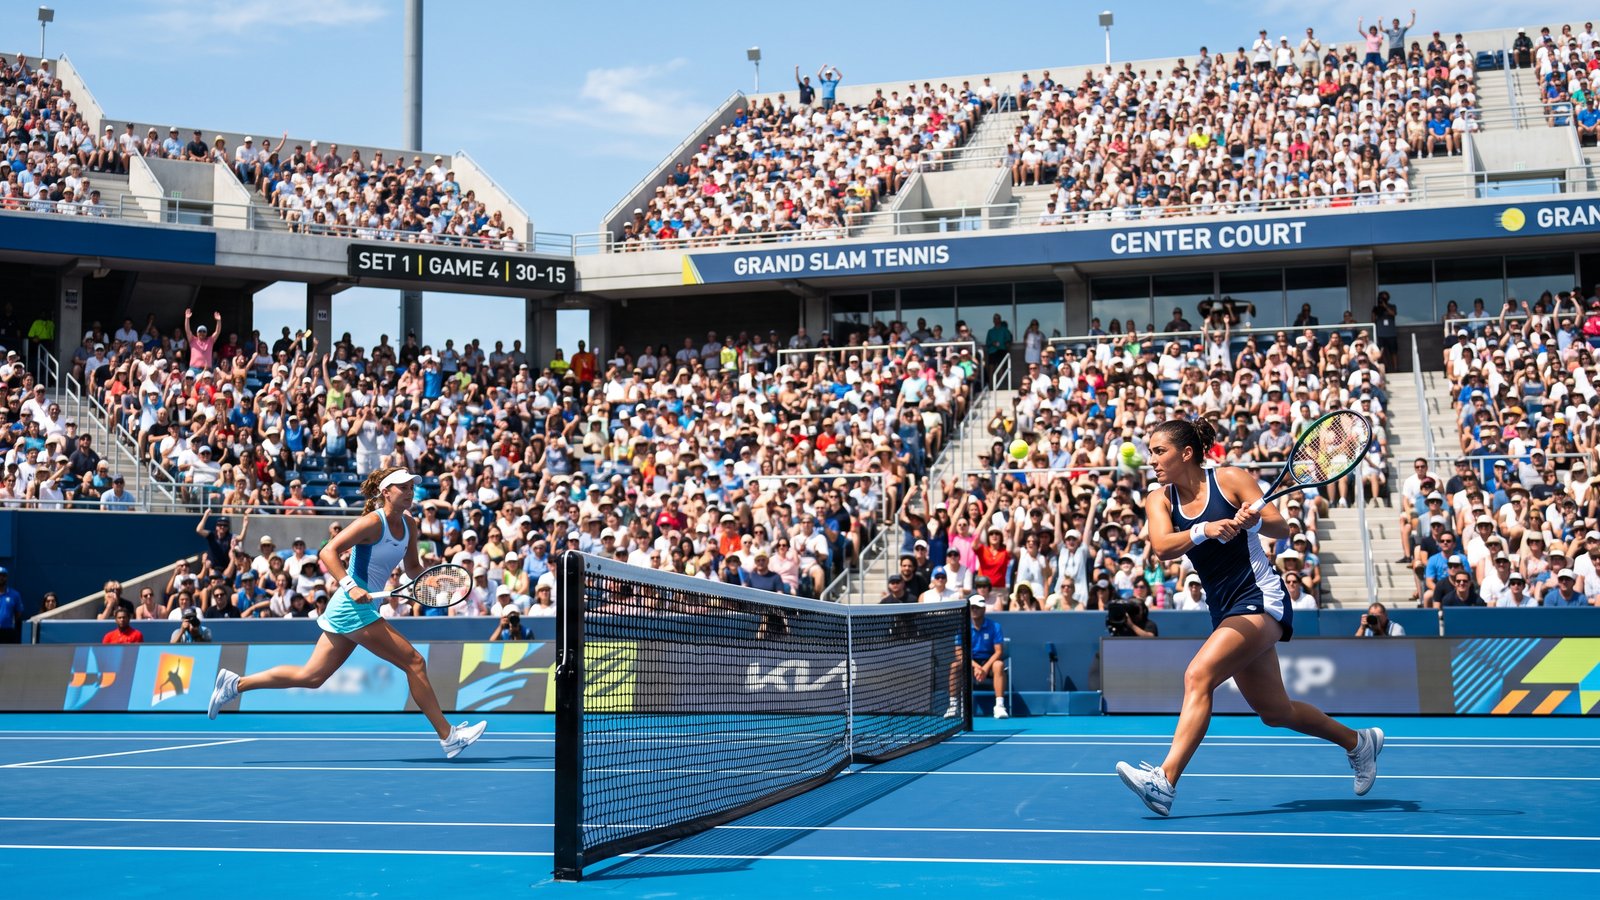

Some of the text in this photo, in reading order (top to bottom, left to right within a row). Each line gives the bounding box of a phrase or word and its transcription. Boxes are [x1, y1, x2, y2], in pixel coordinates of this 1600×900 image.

[1110, 221, 1307, 255] CENTER COURT
[358, 252, 566, 284] SET 1 GAME 4 30-15
[733, 245, 950, 276] GRAND SLAM TENNIS
